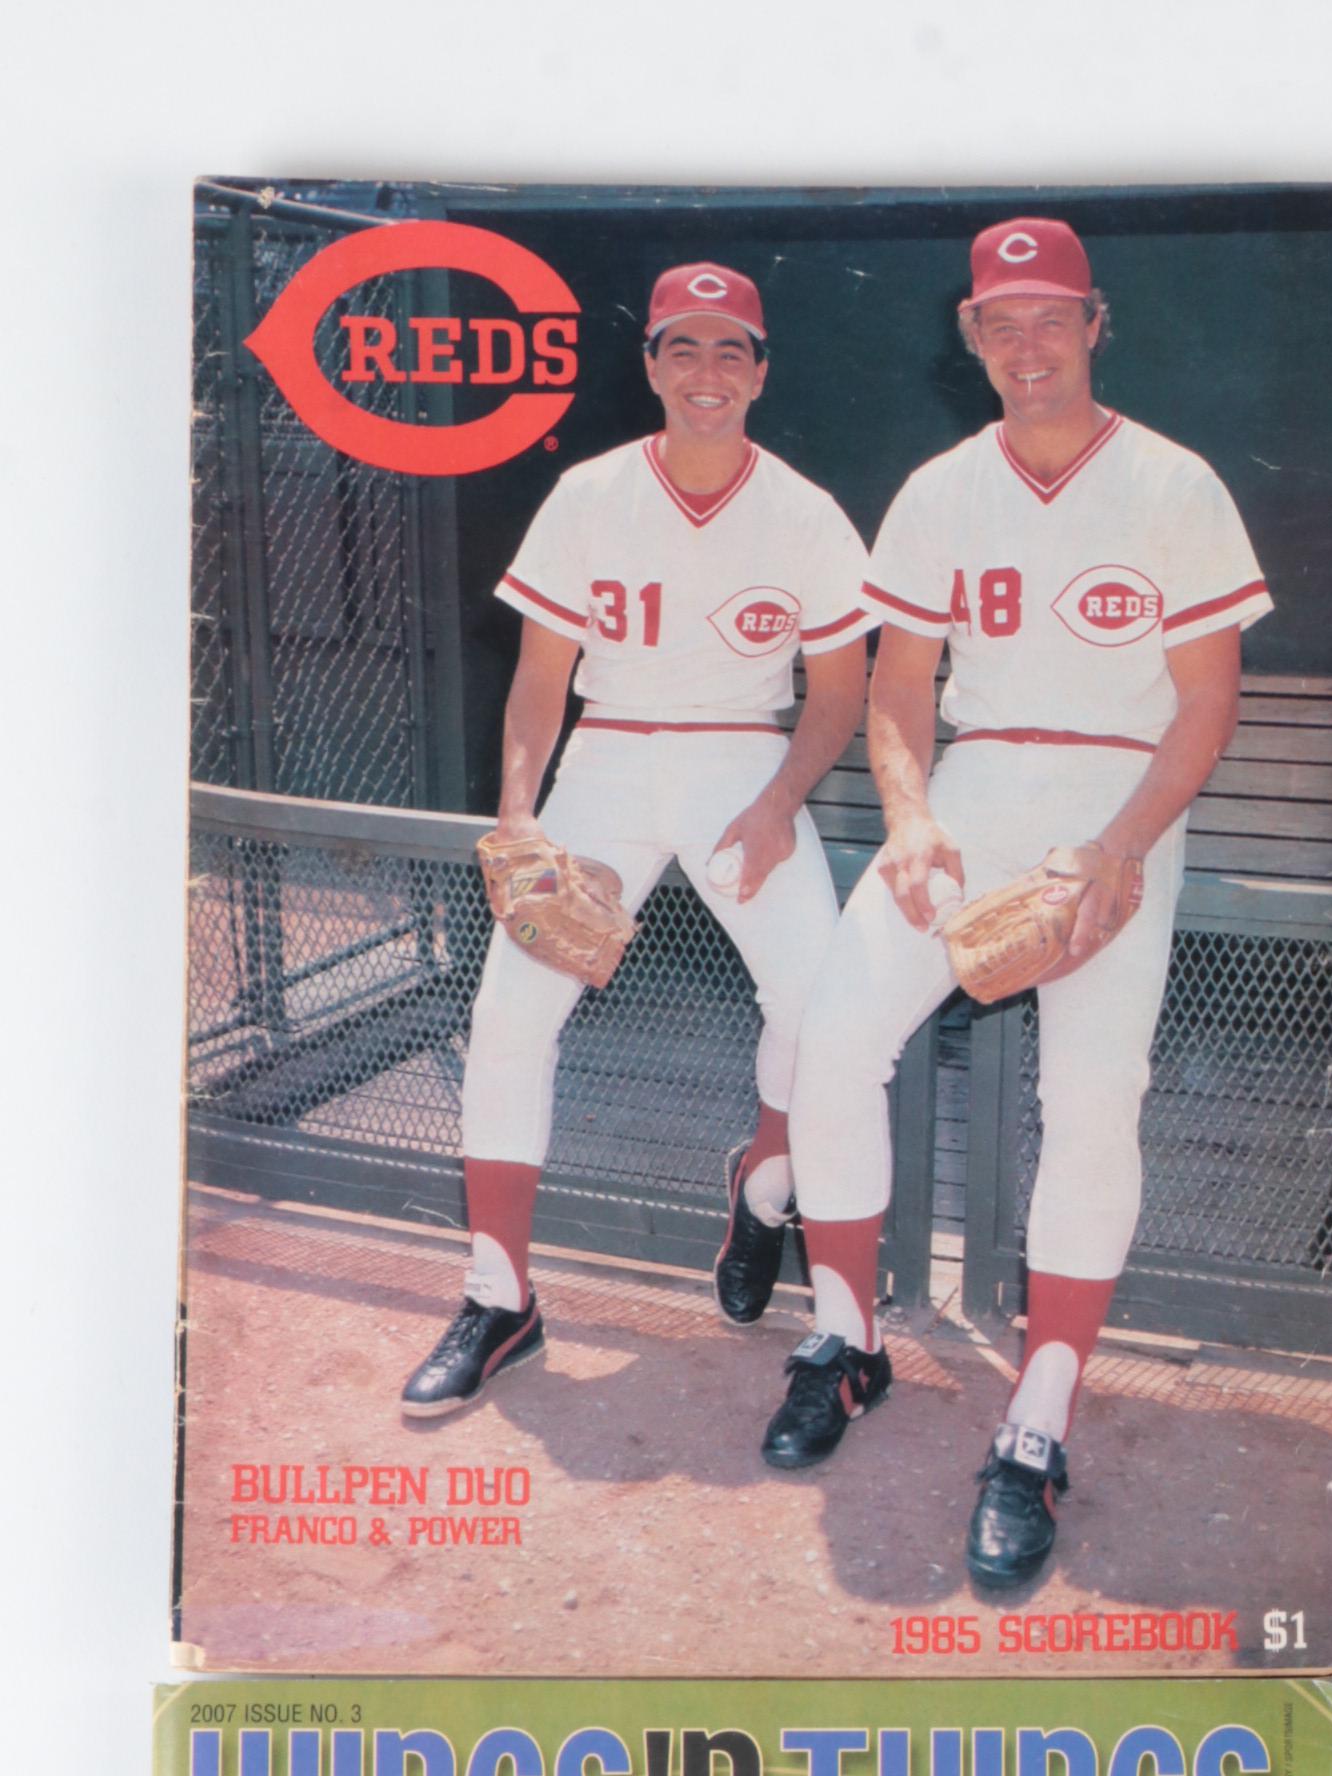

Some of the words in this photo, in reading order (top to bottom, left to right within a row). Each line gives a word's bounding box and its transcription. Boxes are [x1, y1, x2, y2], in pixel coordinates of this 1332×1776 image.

[340, 316, 578, 385] REDS
[588, 580, 662, 648] 31
[741, 611, 797, 633] REDS
[1086, 595, 1159, 618] REDS
[230, 1464, 429, 1506] BULLPEN
[446, 1467, 531, 1507] DUO
[230, 1514, 358, 1546] FRANCO
[369, 1517, 393, 1546] &
[408, 1516, 522, 1546] POWER
[890, 1616, 981, 1655] 1985
[999, 1610, 1240, 1653] SCOREBOOK
[1263, 1609, 1307, 1652] $1
[190, 1704, 237, 1723] 2007
[244, 1704, 302, 1723] ISSUE
[310, 1704, 343, 1723] NO.
[351, 1704, 362, 1723] 3
